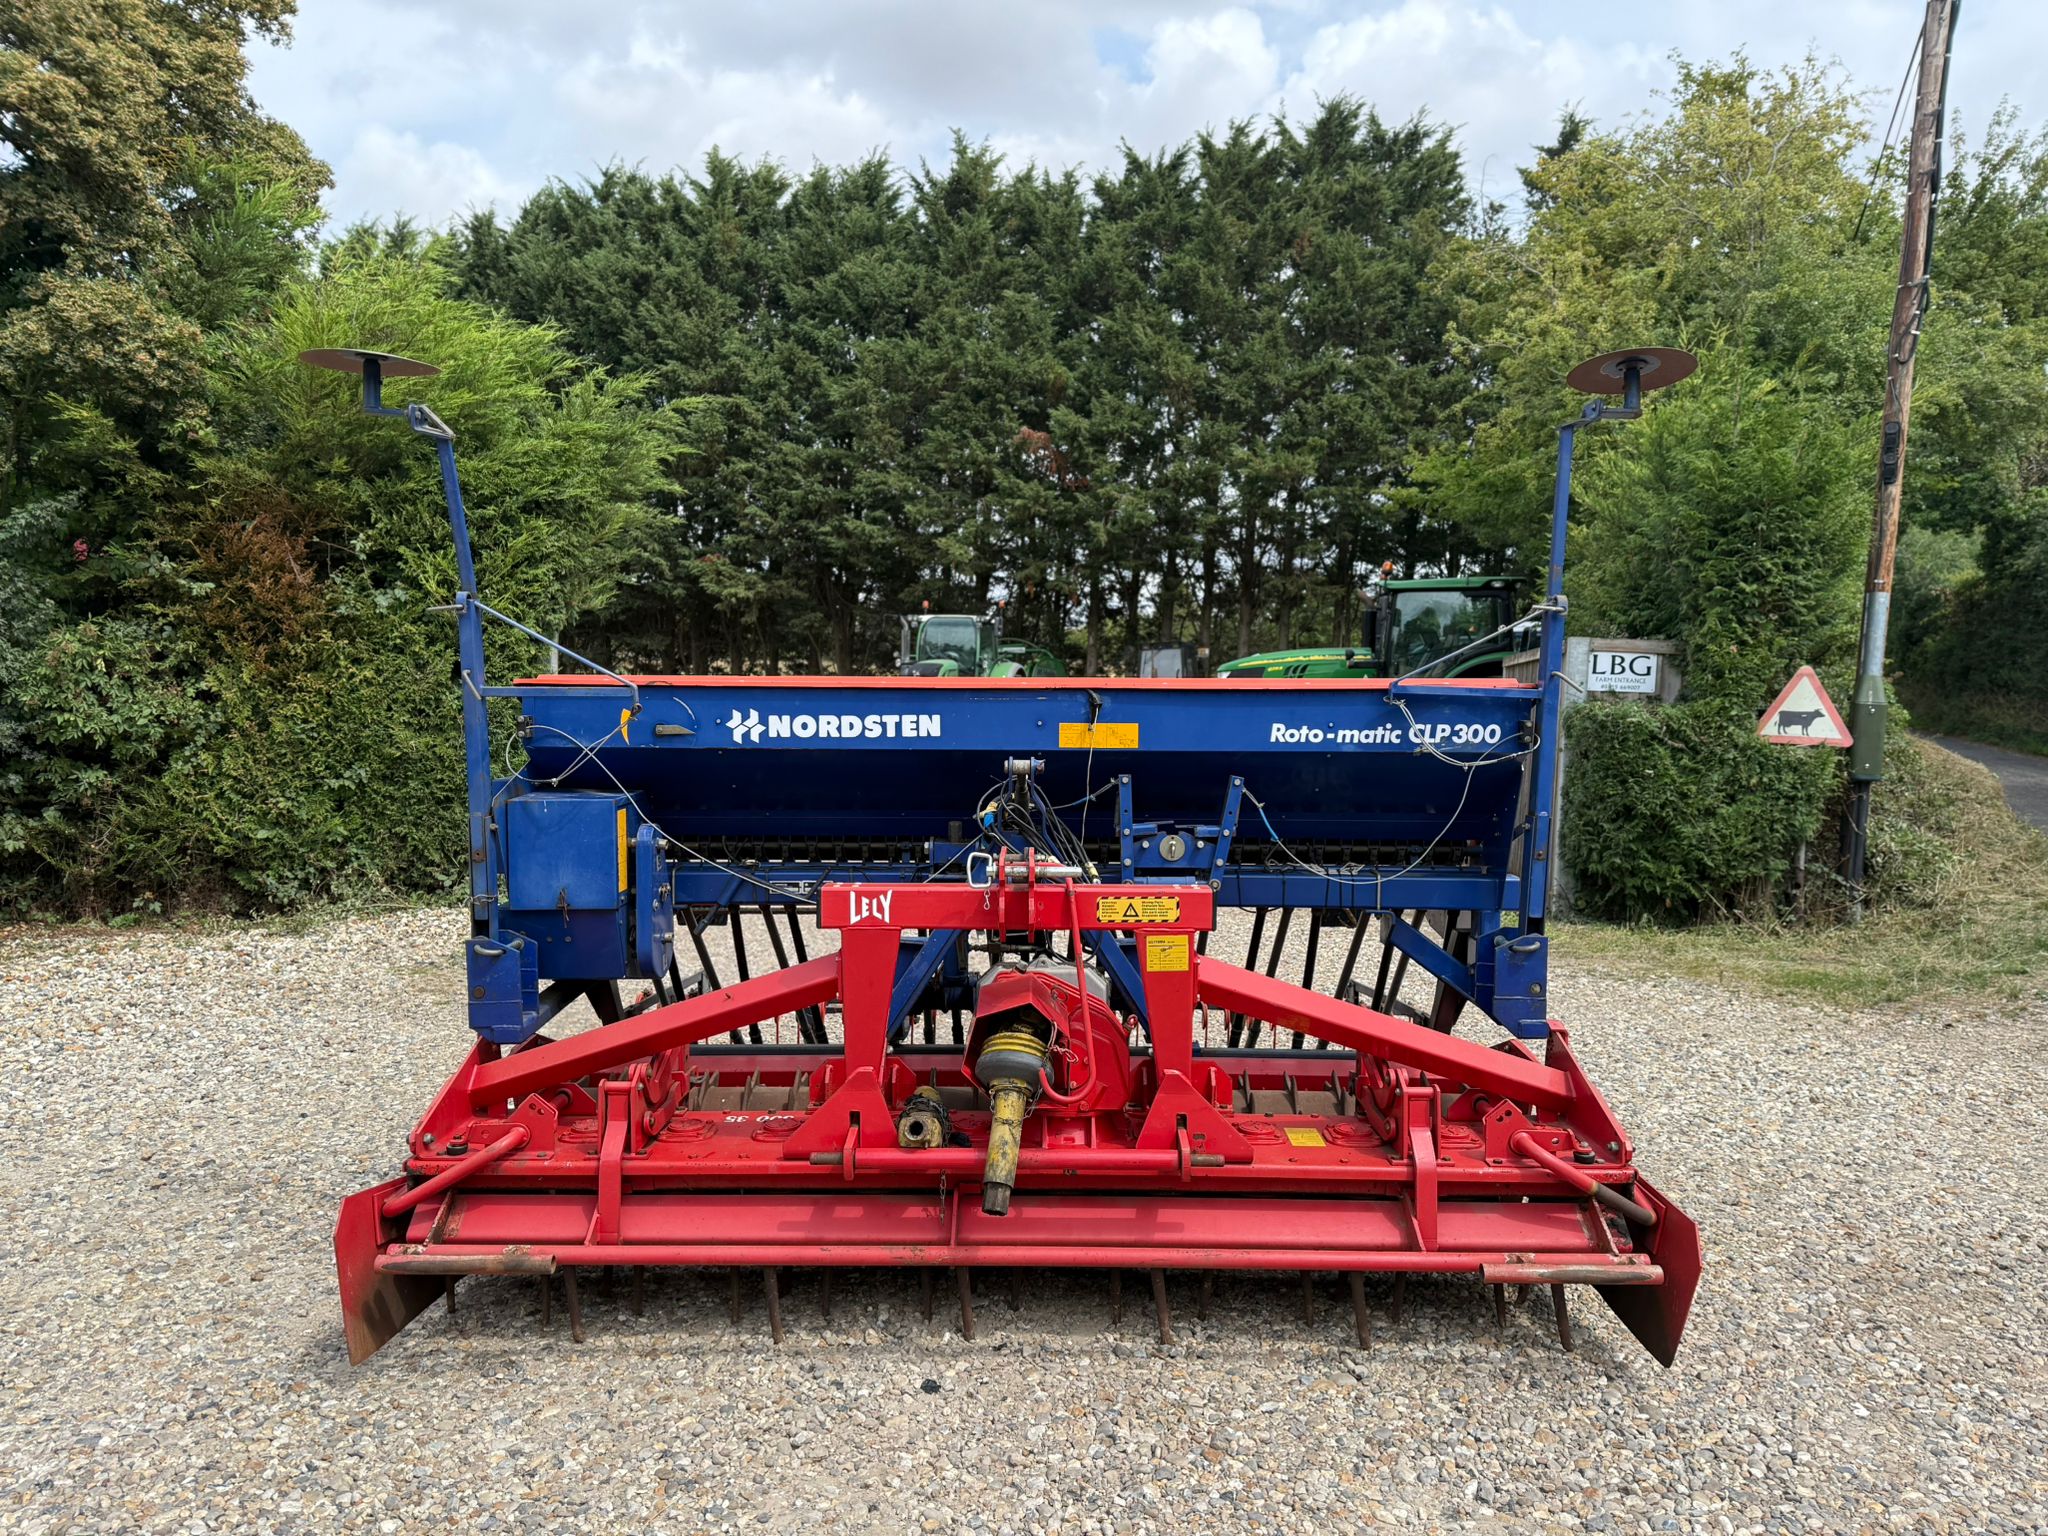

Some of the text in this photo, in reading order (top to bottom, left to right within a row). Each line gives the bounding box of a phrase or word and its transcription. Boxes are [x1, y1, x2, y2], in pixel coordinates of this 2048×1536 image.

[1592, 654, 1652, 676] LBG
[768, 714, 941, 738] NORDSTEN
[1270, 722, 1402, 744] Roto-matic
[850, 889, 893, 925] LELY
